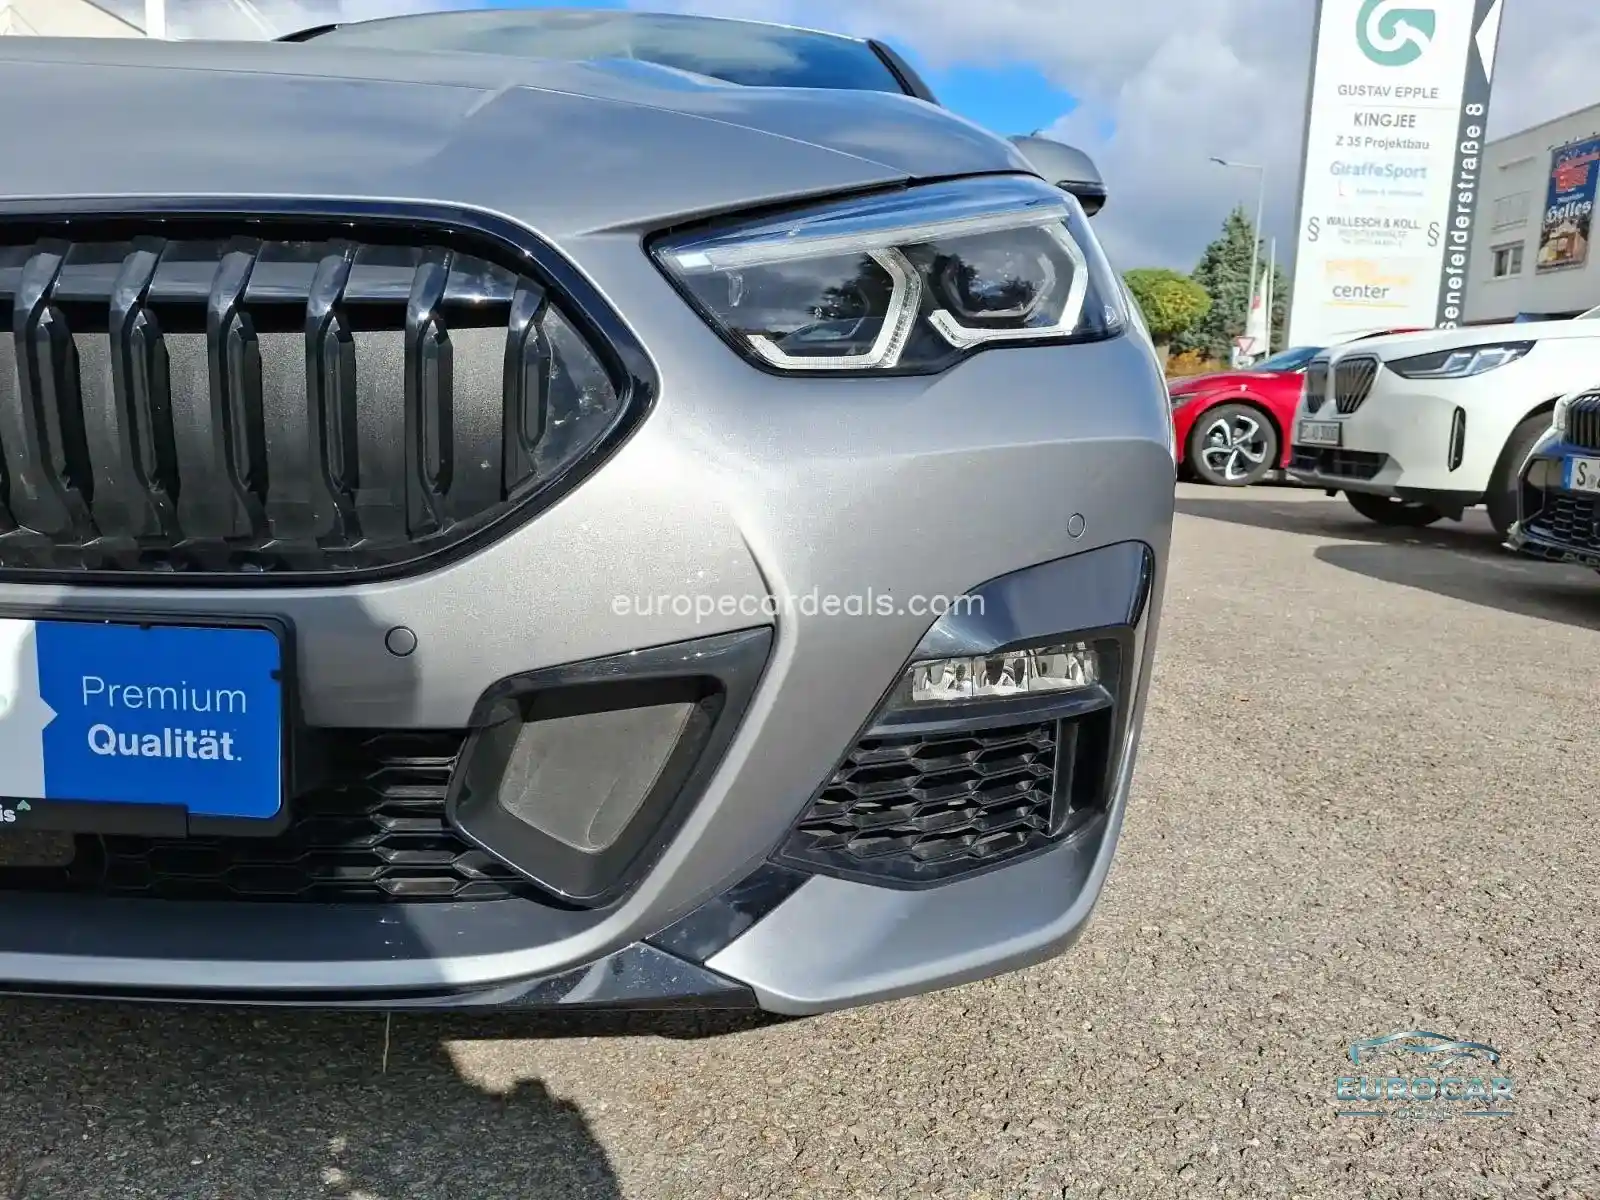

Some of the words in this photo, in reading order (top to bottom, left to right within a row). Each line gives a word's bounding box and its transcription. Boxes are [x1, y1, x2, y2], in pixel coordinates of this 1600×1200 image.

[1338, 84, 1391, 98] GUSTAV
[1395, 86, 1440, 99] EPPLE
[1465, 103, 1484, 116] 8
[1353, 112, 1416, 129] KINGJEE
[1335, 135, 1344, 146] Z
[1347, 136, 1361, 147] 35
[1365, 137, 1430, 150] Projektbau
[1330, 161, 1428, 180] GiraffeSport
[1326, 216, 1382, 228] WALLESCH
[1383, 217, 1390, 229] &
[1332, 282, 1390, 299] center
[82, 675, 247, 713] Premium
